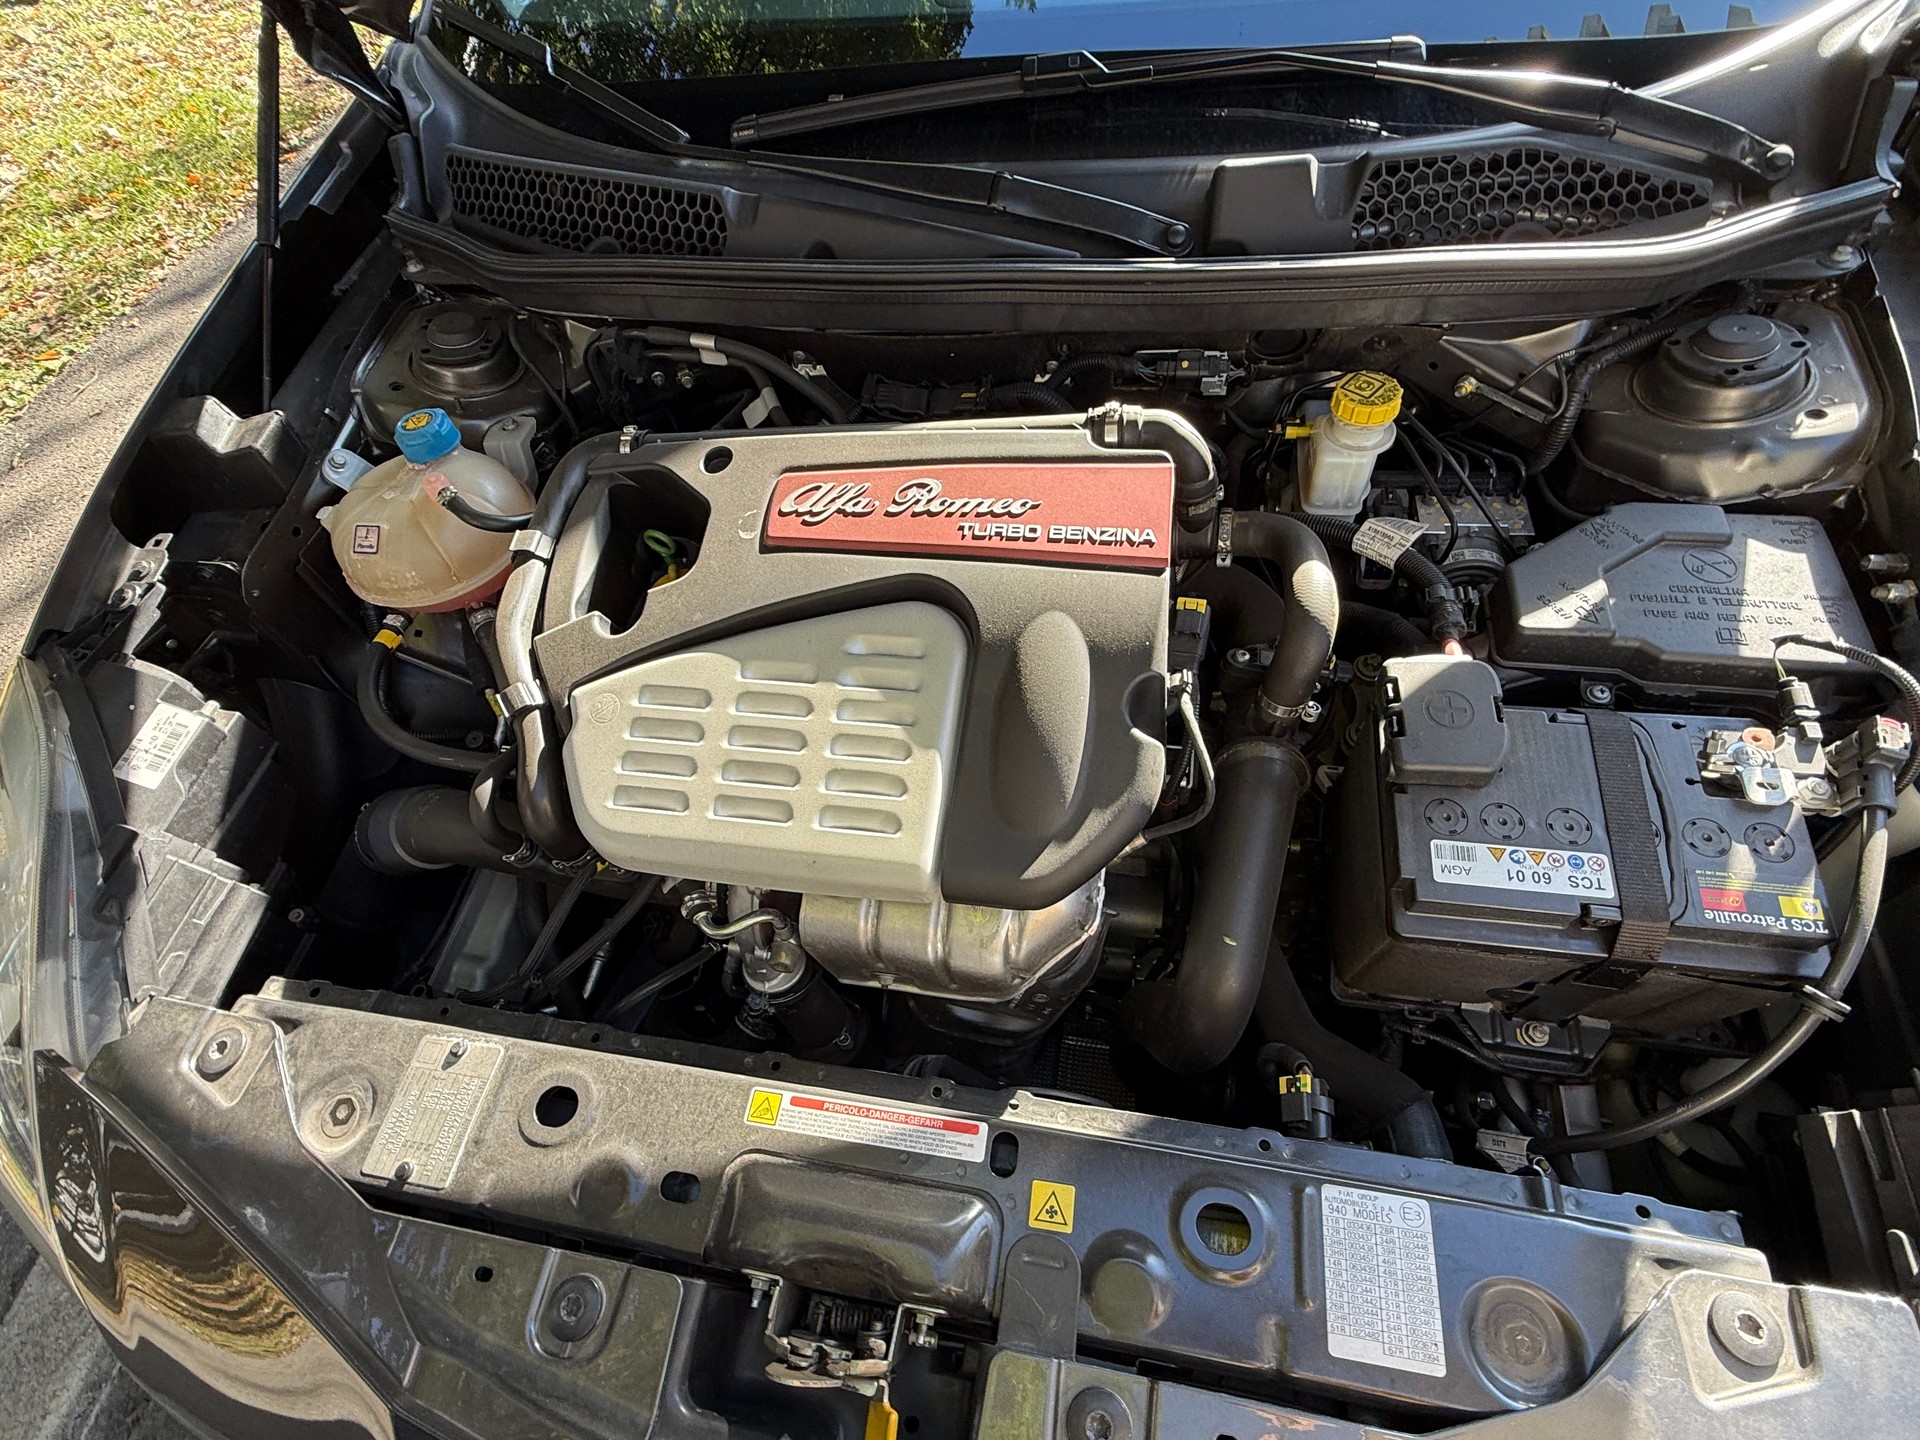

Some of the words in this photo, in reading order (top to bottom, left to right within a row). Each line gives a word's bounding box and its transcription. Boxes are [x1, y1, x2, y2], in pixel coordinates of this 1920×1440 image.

[779, 482, 880, 526] Alfa
[884, 477, 1043, 518] Romeo
[956, 521, 1042, 541] TURBO
[1047, 525, 1158, 547] BENZINA
[1668, 584, 1750, 597] CENTRALINA
[1536, 594, 1573, 620] SCREW
[1629, 593, 1690, 604] FUSIBILI
[1697, 596, 1708, 605] E
[1712, 597, 1803, 611] TELERUTTORI
[1642, 608, 1678, 619] FUSE
[1684, 611, 1710, 621] AND
[1717, 613, 1759, 624] RELAY
[1765, 616, 1793, 626] BOX
[1441, 864, 1472, 876] AGM
[1507, 870, 1525, 882] 01
[1532, 871, 1552, 885] 60
[1568, 875, 1606, 890] TCS
[1704, 909, 1789, 930] Patrouille
[1792, 920, 1829, 934] TCS
[823, 1103, 944, 1128] PERICOLO-DANGER-GEFAHR
[1323, 1194, 1368, 1209] AUTOMOBILES
[1338, 1189, 1353, 1198] FIAT
[1357, 1192, 1379, 1203] GROUP
[1401, 1205, 1422, 1222] E3
[1327, 1203, 1347, 1217] 940
[1352, 1207, 1392, 1224] MODELS
[1325, 1217, 1339, 1226] 11R
[1379, 1226, 1395, 1235] 28R
[1325, 1227, 1340, 1236] 12R
[1324, 1237, 1344, 1247] 13HR
[1381, 1246, 1396, 1256] 39R
[1324, 1247, 1344, 1258] 13HR
[1381, 1257, 1397, 1267] 46R
[1327, 1258, 1342, 1268] 14R
[1382, 1267, 1398, 1277] 48R
[1327, 1268, 1343, 1278] 16R
[1383, 1278, 1399, 1288] 51R
[1326, 1279, 1346, 1290] 17RA
[1383, 1289, 1400, 1299] 51R
[1328, 1290, 1344, 1300] 21R
[1384, 1300, 1400, 1310] 51R
[1328, 1301, 1344, 1311] 26R
[1385, 1311, 1401, 1321] 51R
[1327, 1311, 1348, 1323] 13HR
[1386, 1322, 1402, 1333] 64R
[1330, 1323, 1346, 1334] 51R
[1386, 1333, 1403, 1344] 51R
[1387, 1345, 1404, 1356] 67R
